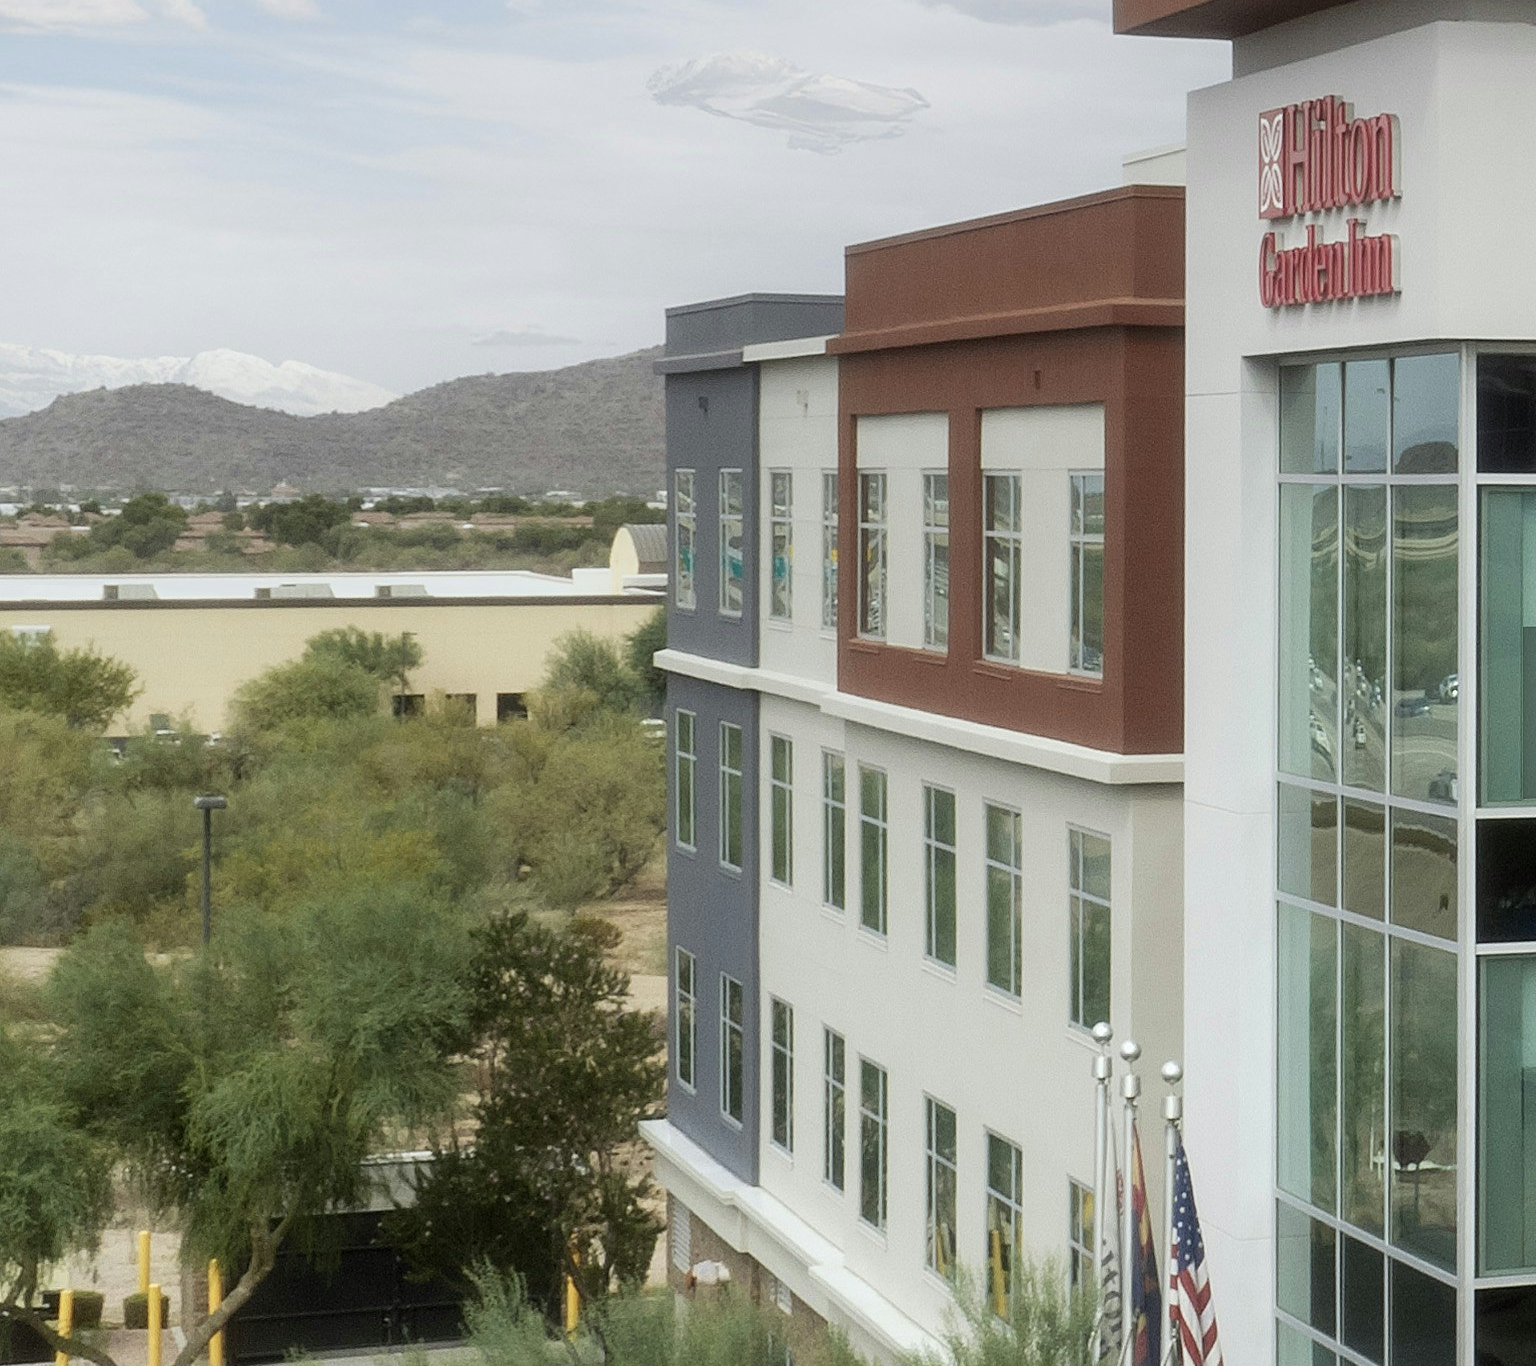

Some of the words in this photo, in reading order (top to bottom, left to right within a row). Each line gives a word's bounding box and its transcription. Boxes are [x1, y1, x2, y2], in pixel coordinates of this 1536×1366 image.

[1284, 95, 1394, 215] Hilton
[1259, 225, 1344, 308] Garden
[1346, 218, 1394, 296] Inn
